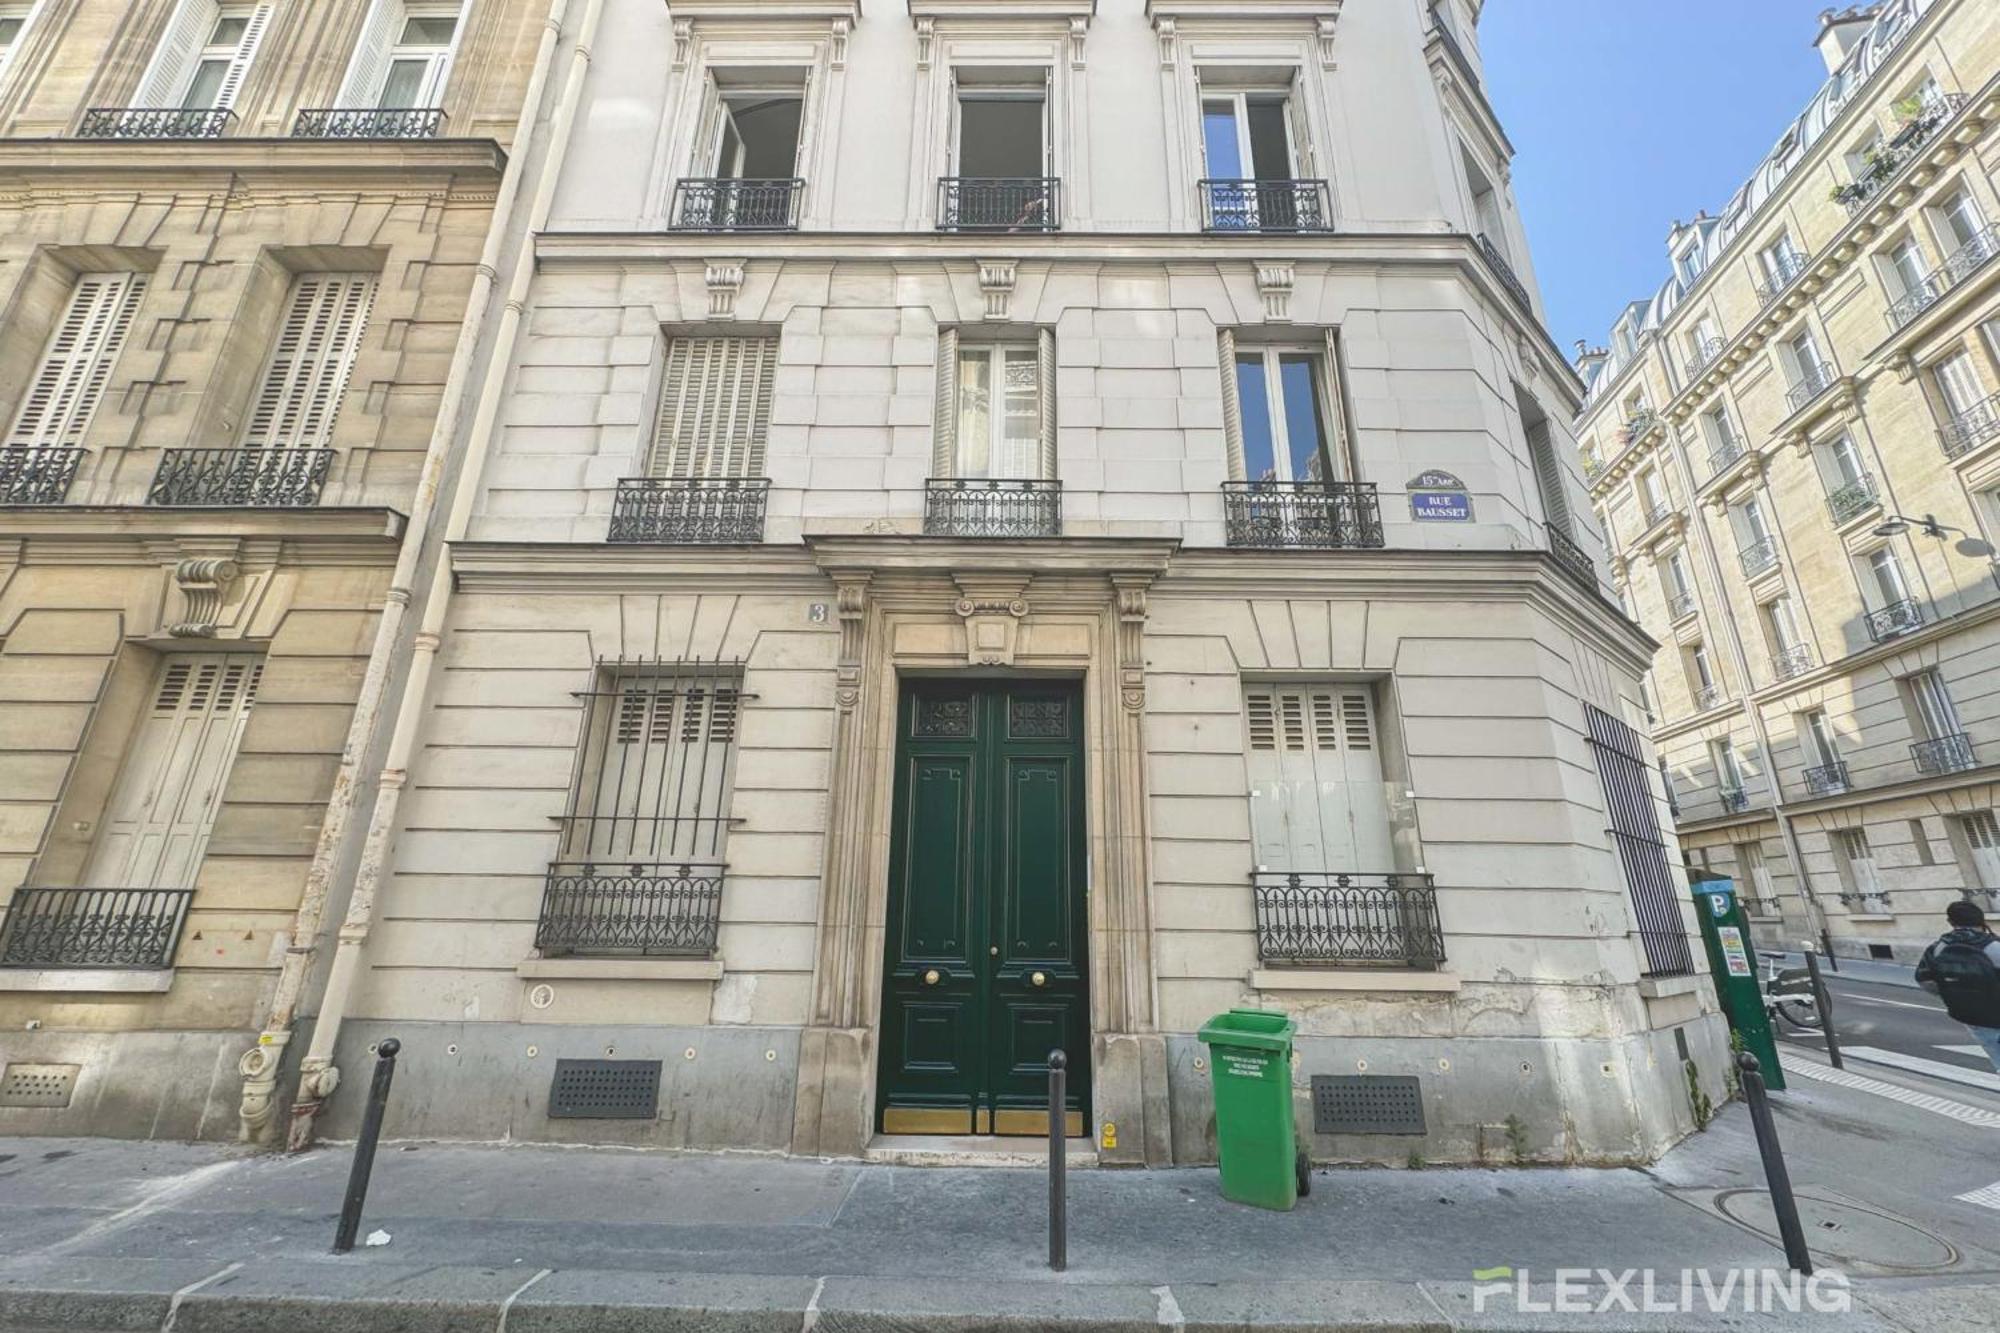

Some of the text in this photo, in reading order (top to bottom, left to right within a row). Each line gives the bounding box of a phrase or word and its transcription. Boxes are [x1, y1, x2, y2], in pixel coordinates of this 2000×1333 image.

[1429, 496, 1451, 505] RUE
[1417, 507, 1466, 517] BAUSSET
[812, 604, 825, 623] 3
[1711, 895, 1724, 912] P
